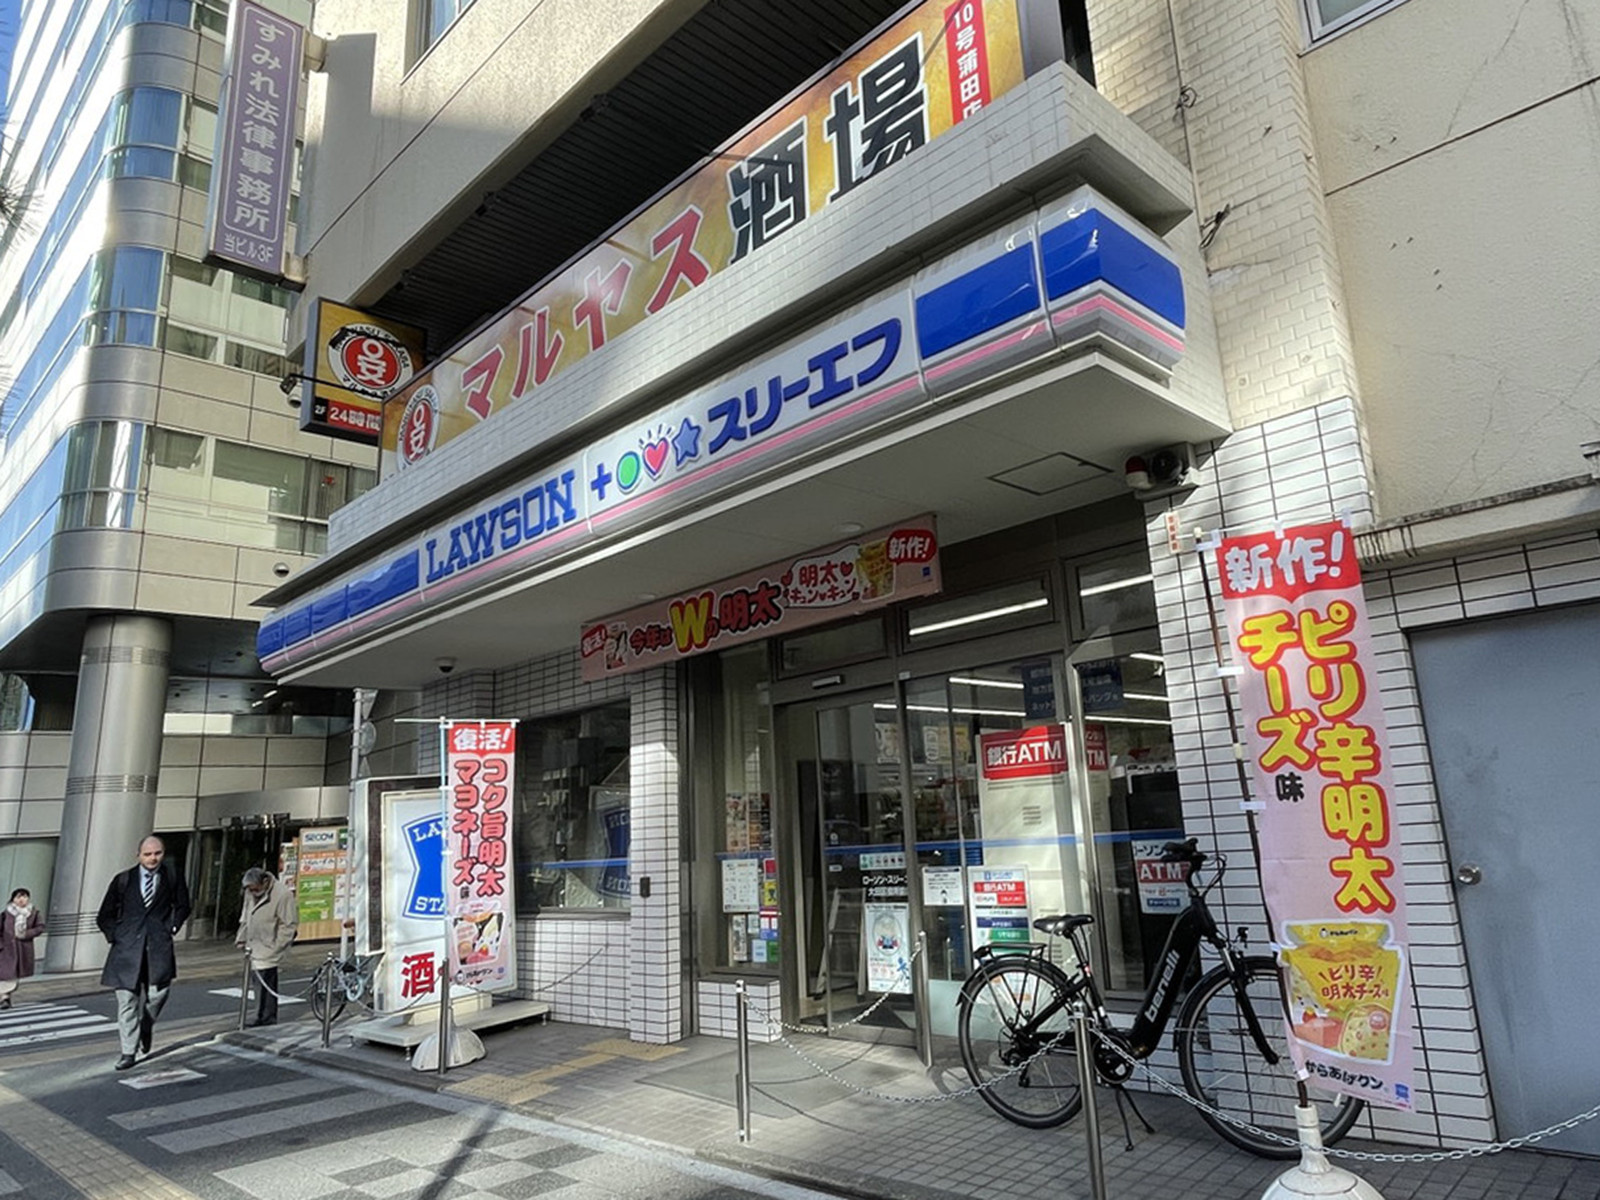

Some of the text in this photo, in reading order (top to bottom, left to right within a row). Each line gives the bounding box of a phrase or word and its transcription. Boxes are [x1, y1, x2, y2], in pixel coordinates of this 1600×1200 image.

[234, 17, 286, 236] すみれ法律事務所
[223, 233, 274, 264] 当ビル3F
[426, 469, 577, 584] LAWSON
[707, 317, 903, 455] スリーエフ
[800, 561, 839, 588] 明太
[1225, 531, 1344, 593] 新作!
[453, 728, 511, 751] 復活!
[1299, 600, 1395, 912] ピリ辛明太
[476, 759, 508, 897] コク旨明太
[1140, 862, 1182, 880] ATM
[401, 951, 435, 998] 酒
[1144, 949, 1180, 1023] benelli
